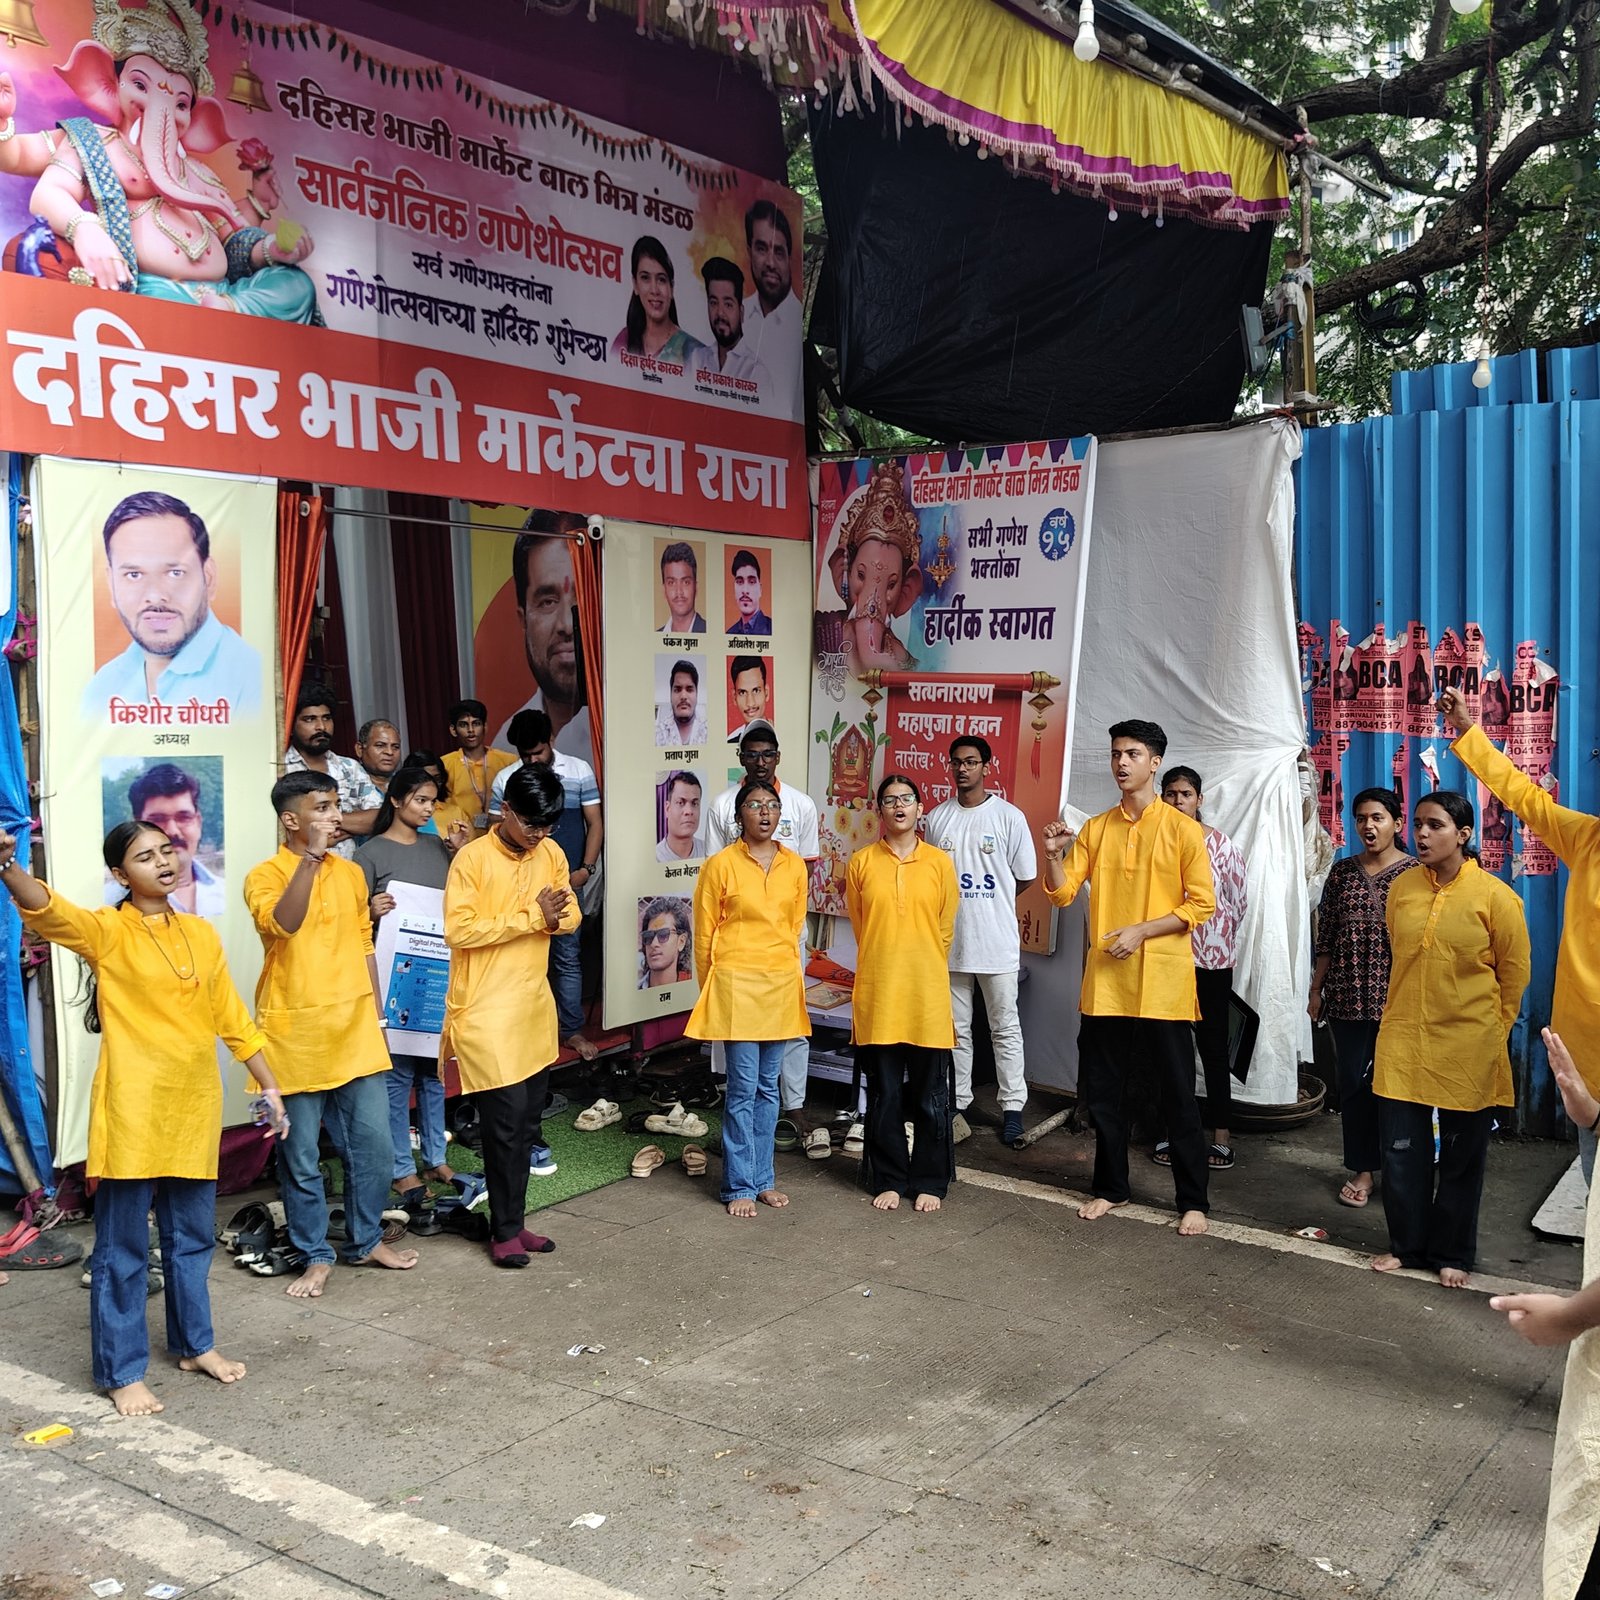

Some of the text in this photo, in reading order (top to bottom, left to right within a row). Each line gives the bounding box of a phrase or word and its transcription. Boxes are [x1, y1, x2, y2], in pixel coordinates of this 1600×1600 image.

[278, 78, 693, 232] दहिसर भाजी मार्केट बाल मित्र मंडळ
[295, 157, 623, 283] सार्वजनिक गणेशोत्सव
[412, 251, 553, 305] सर्व गणेशभक्तांना
[326, 269, 607, 365] गणेशोत्सवाच्या हार्दिक शुभेच्छा
[713, 371, 734, 388] प्रकाश
[7, 308, 789, 509] दहिसर भाजी मार्केटचा राजा
[913, 471, 945, 504] दहिसर
[946, 467, 973, 501] भाजी
[1005, 471, 1026, 497] बाळ
[1028, 461, 1051, 496] मित्र
[1053, 459, 1082, 493] मंडळ
[1049, 510, 1068, 528] वर्ष
[968, 517, 1028, 548] सभी गणेश
[925, 594, 1056, 645] हार्दीक स्वागत
[663, 634, 698, 651] पंकज गुप्ता
[728, 637, 769, 652] अखिलेश गुप्ता
[1359, 660, 1403, 688] BCA
[908, 682, 995, 704] सत्यनारायण
[1510, 683, 1555, 713] BCA
[110, 697, 230, 724] किशोर चौधरी
[898, 713, 1002, 741] महापुजा व हवन
[1335, 720, 1402, 729] 8879041517
[153, 733, 190, 746] अध्यक्ष
[665, 750, 698, 763] प्रताप गुप्ता
[932, 777, 952, 802] बजे
[665, 866, 682, 878] केतन
[409, 937, 429, 947] Digital
[660, 992, 671, 1002] राम
